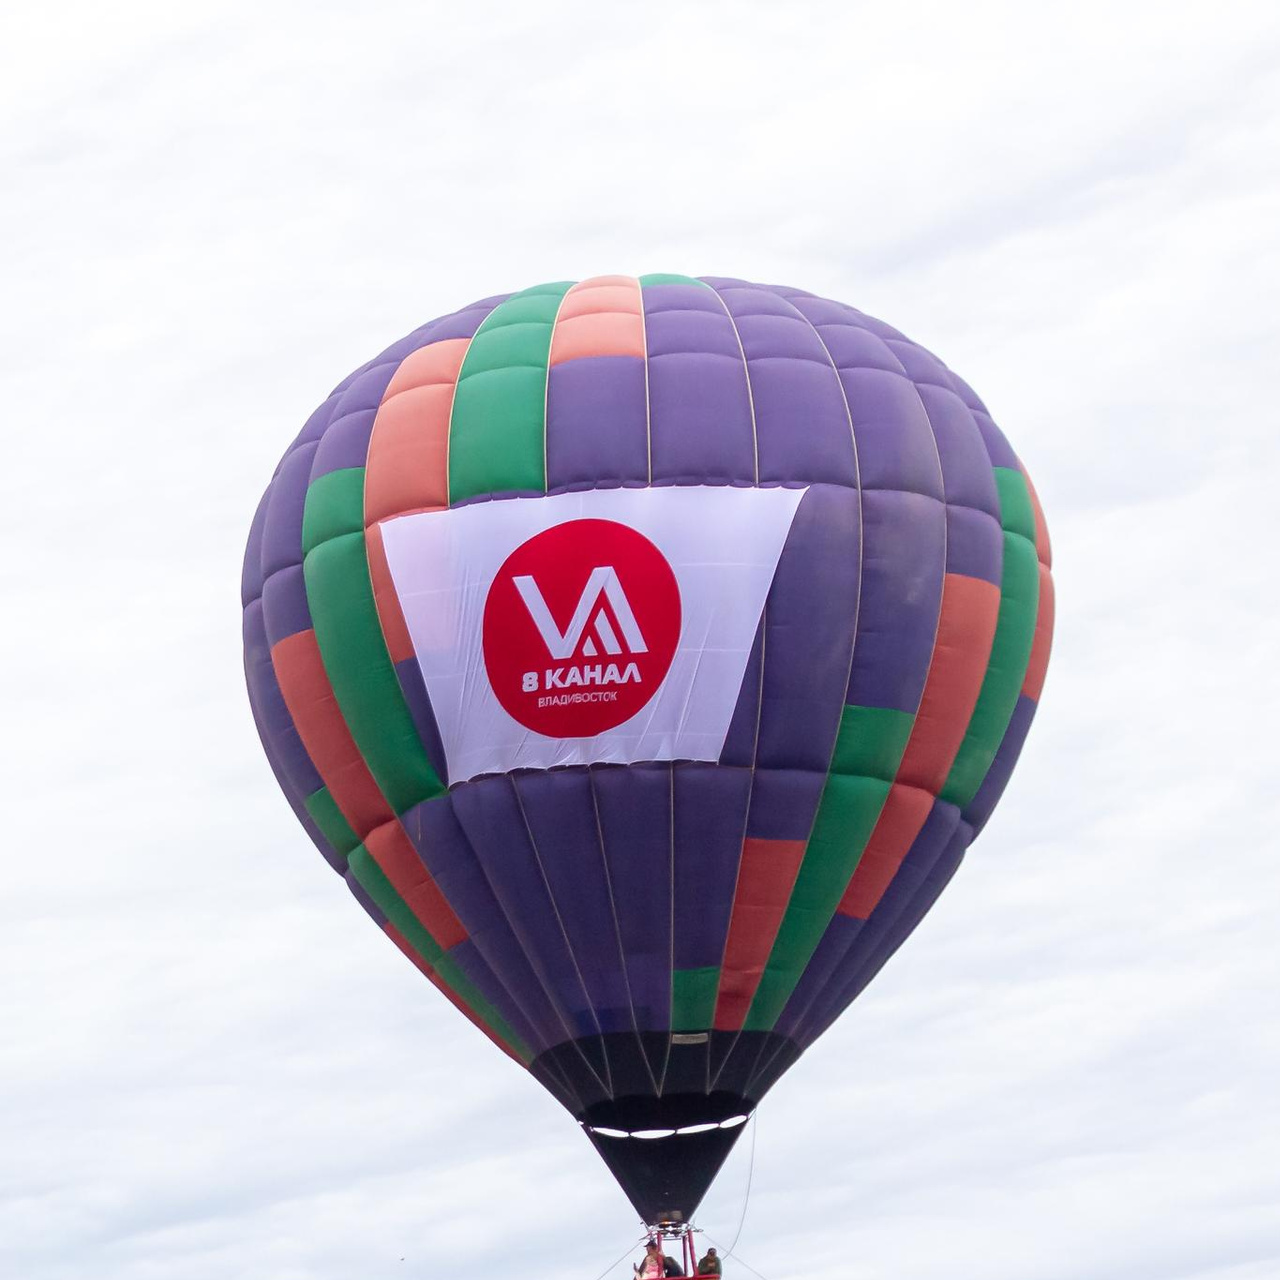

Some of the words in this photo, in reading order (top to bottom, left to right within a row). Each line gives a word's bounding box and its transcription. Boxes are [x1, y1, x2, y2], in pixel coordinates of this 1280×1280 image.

[522, 671, 539, 692] 8
[545, 662, 642, 690] КАНАЛ
[538, 691, 618, 708] ВЛАДИВОСТОК
